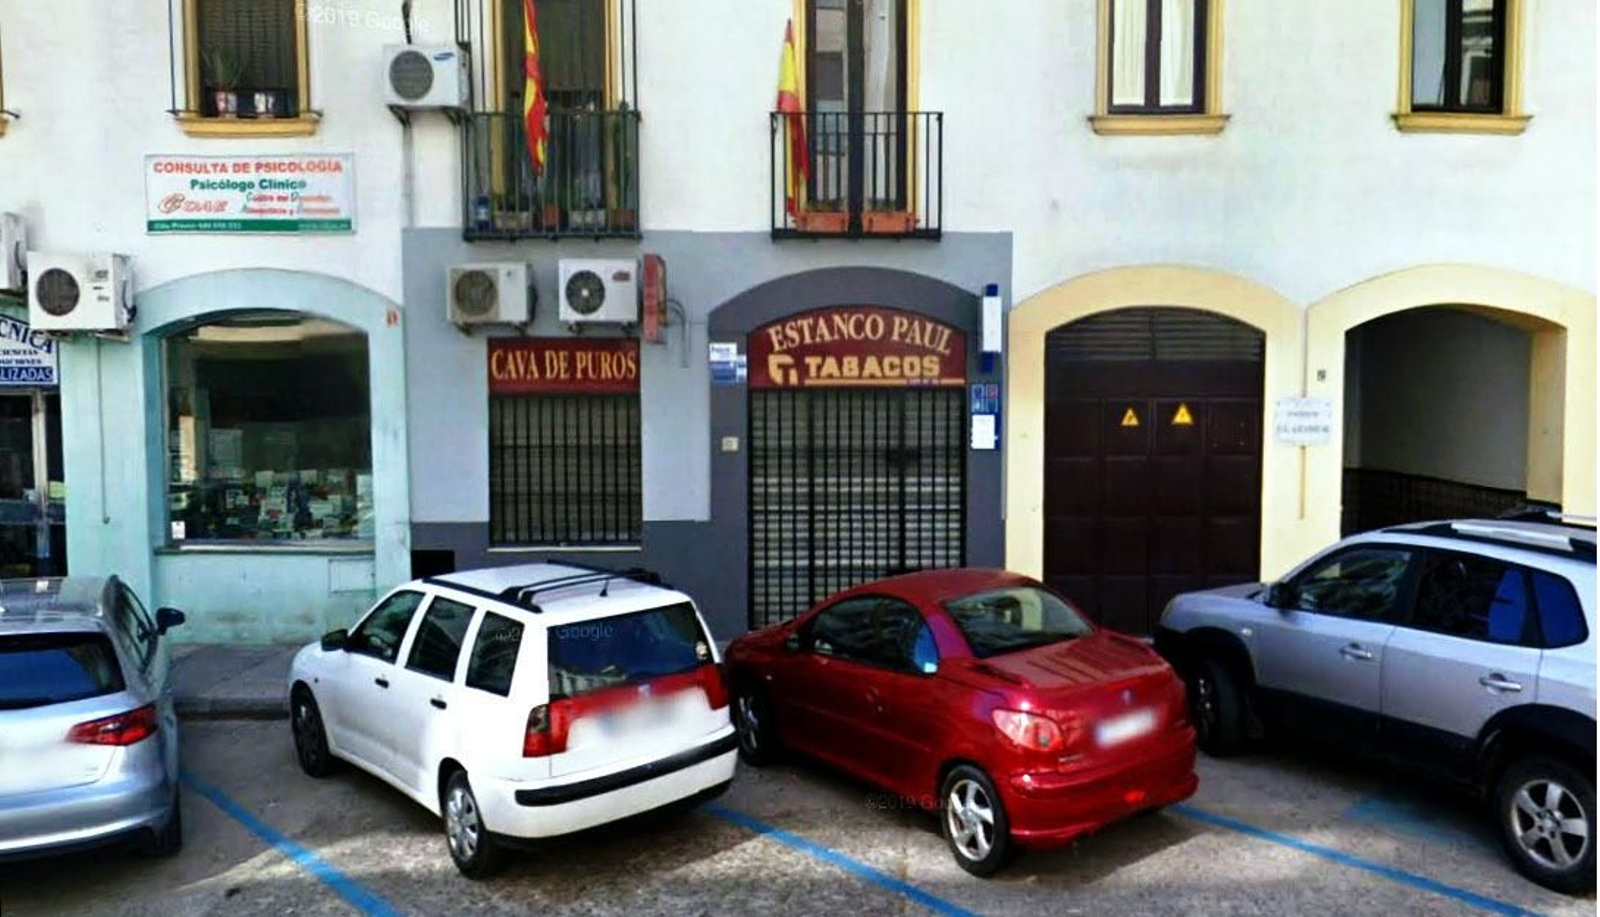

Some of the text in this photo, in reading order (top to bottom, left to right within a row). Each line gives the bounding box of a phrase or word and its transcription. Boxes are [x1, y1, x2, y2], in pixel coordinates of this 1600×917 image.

[153, 161, 229, 174] CONSULTA
[232, 162, 251, 173] DE
[190, 178, 255, 192] Psicólogo
[767, 312, 952, 354] ESTANCO PAUL
[490, 350, 637, 380] CAVA DE PUROS
[804, 355, 941, 378] TABACOS
